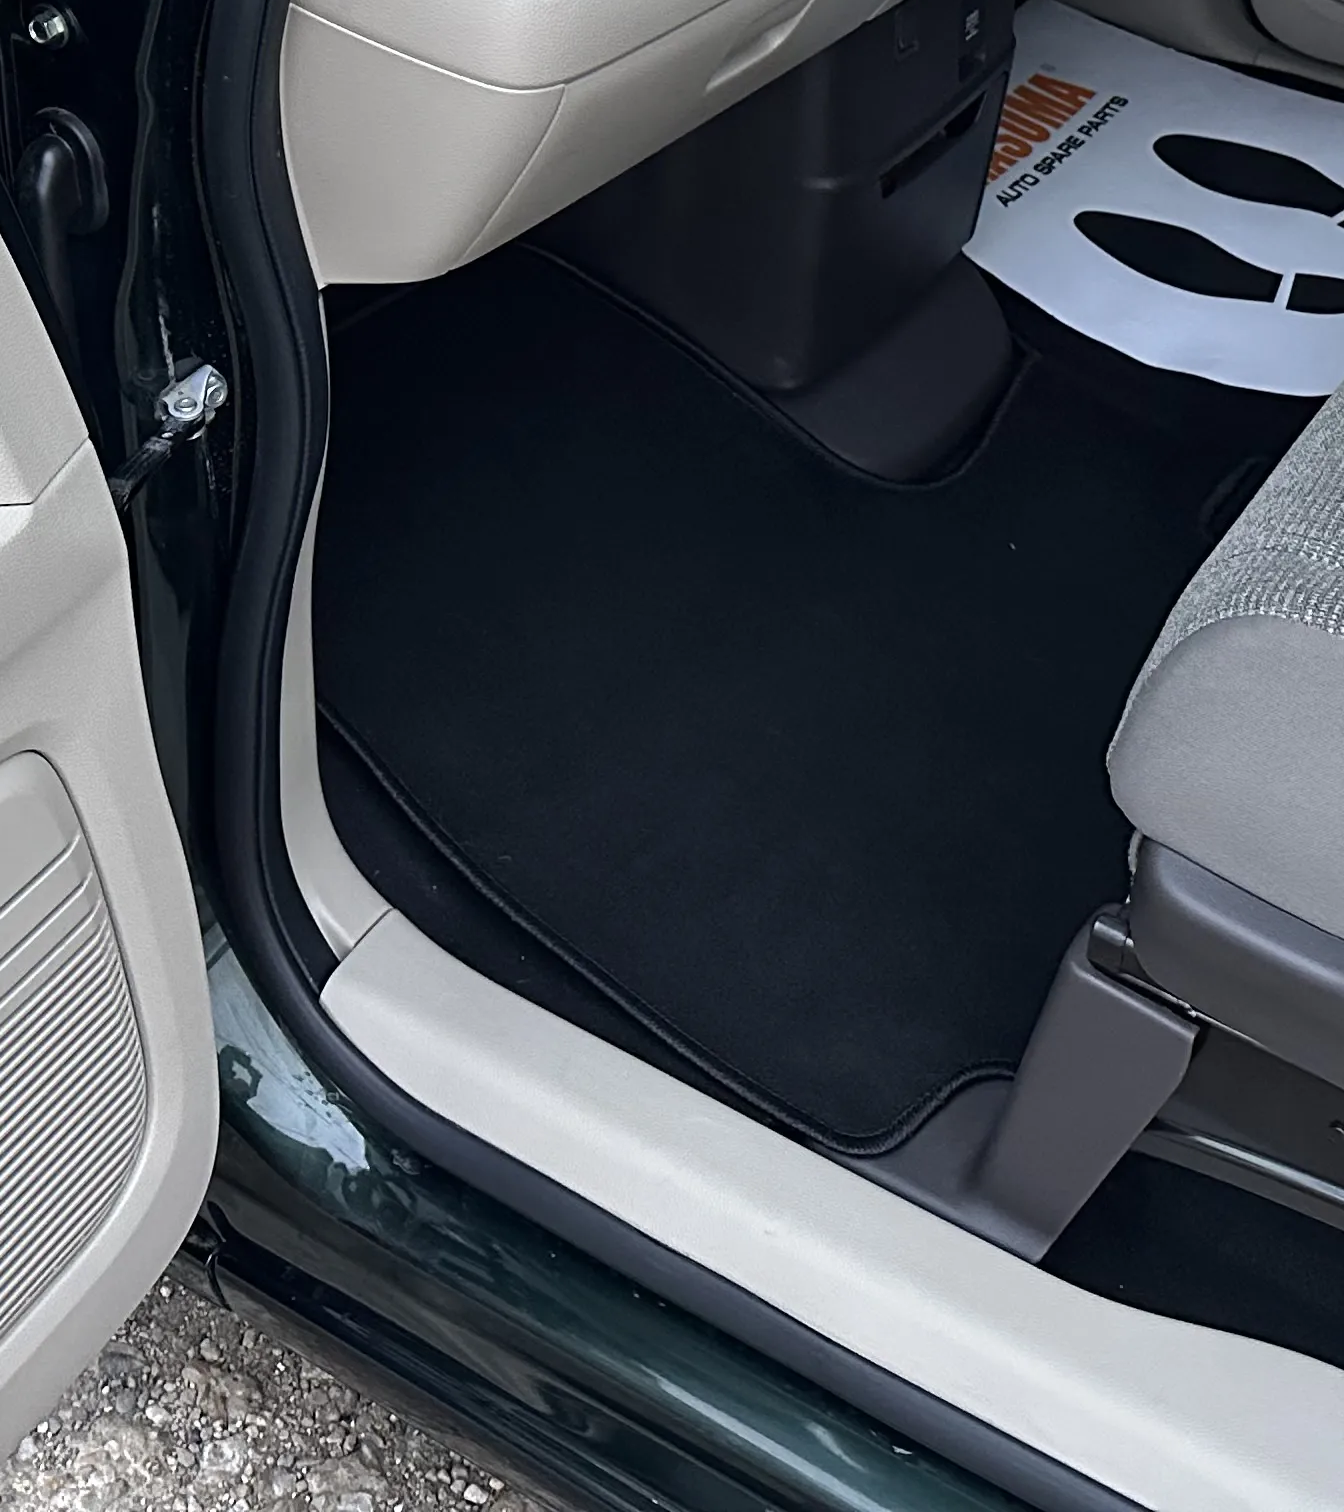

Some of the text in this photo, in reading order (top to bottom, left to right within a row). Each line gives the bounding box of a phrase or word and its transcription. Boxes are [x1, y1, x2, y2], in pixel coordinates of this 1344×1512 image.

[996, 95, 1130, 207] AUTO SPARE PARTS
